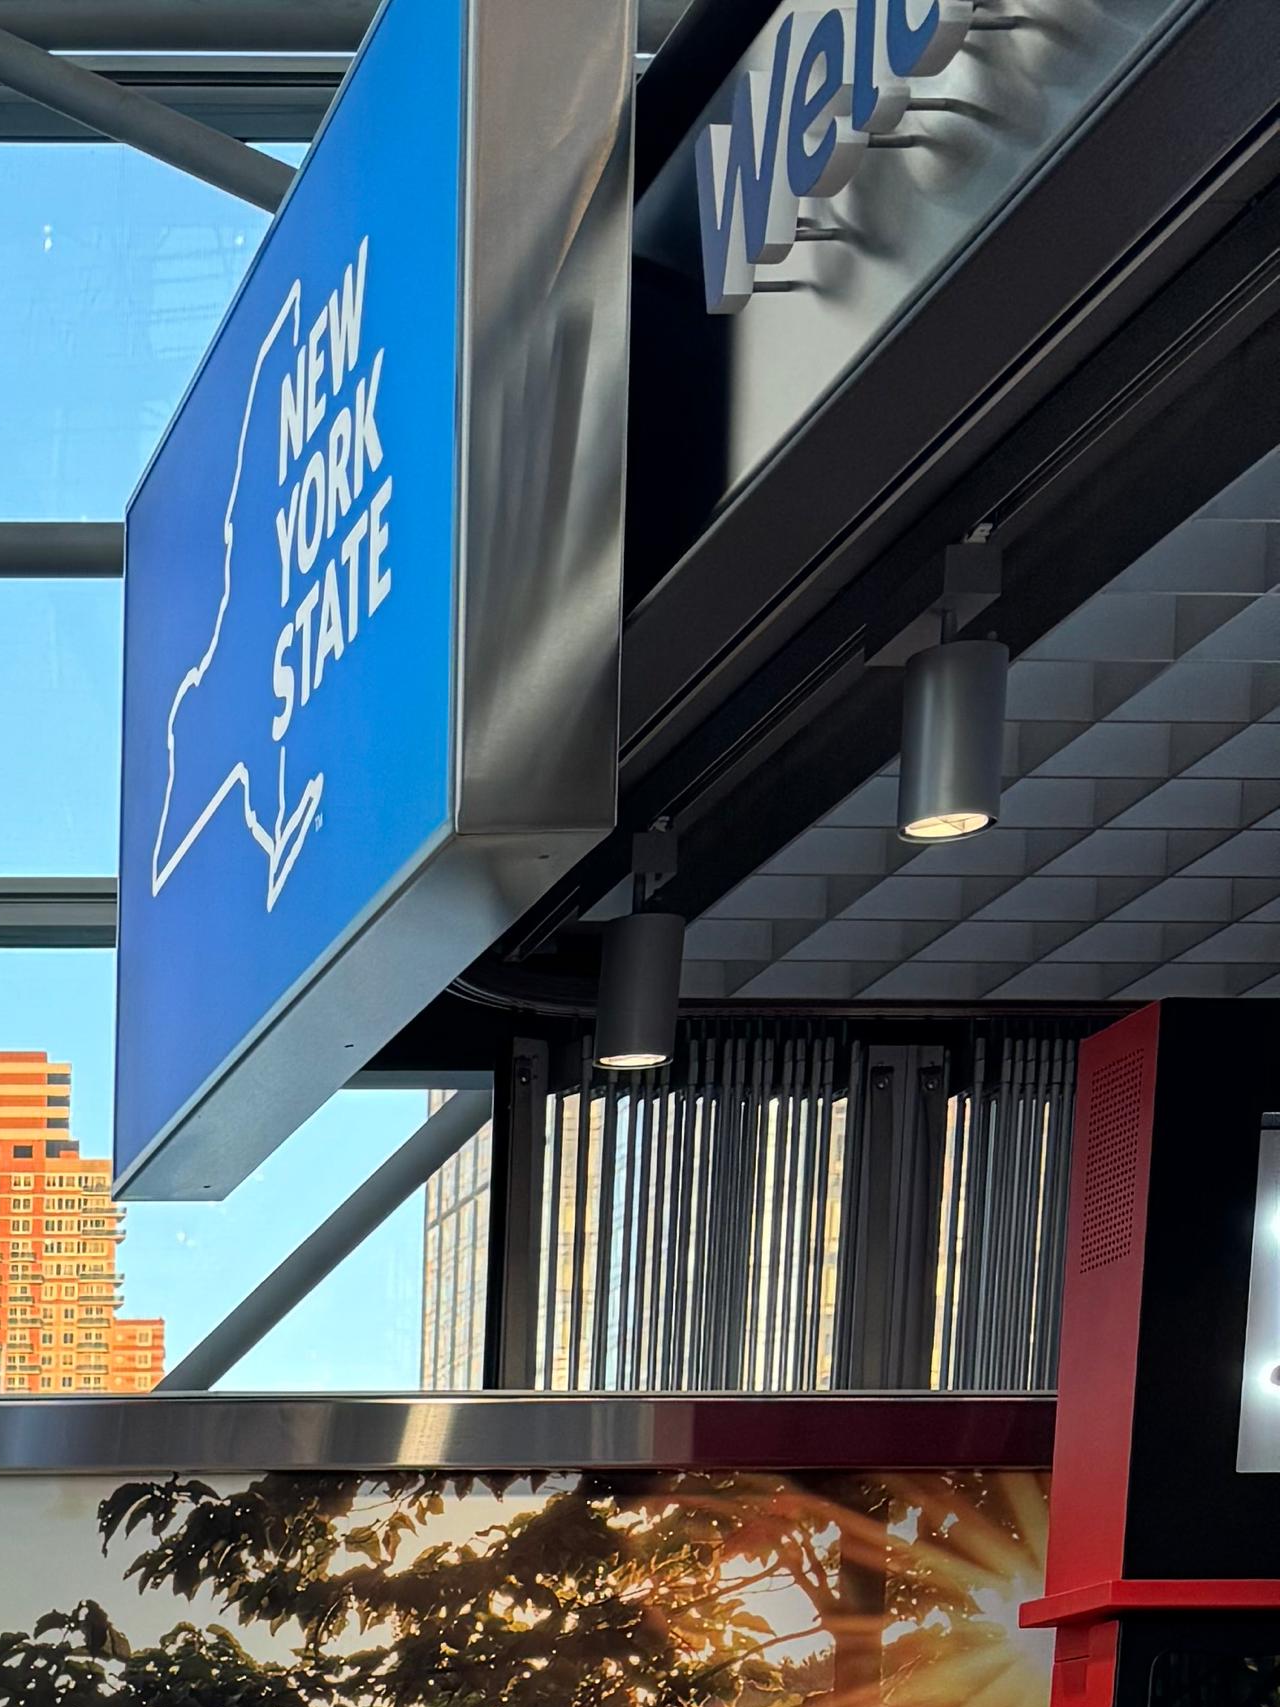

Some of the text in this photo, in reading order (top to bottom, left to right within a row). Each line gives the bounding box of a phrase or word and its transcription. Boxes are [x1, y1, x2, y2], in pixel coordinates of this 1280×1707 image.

[276, 347, 385, 608] YORK
[278, 234, 369, 486] NEW
[272, 475, 393, 741] STATE
